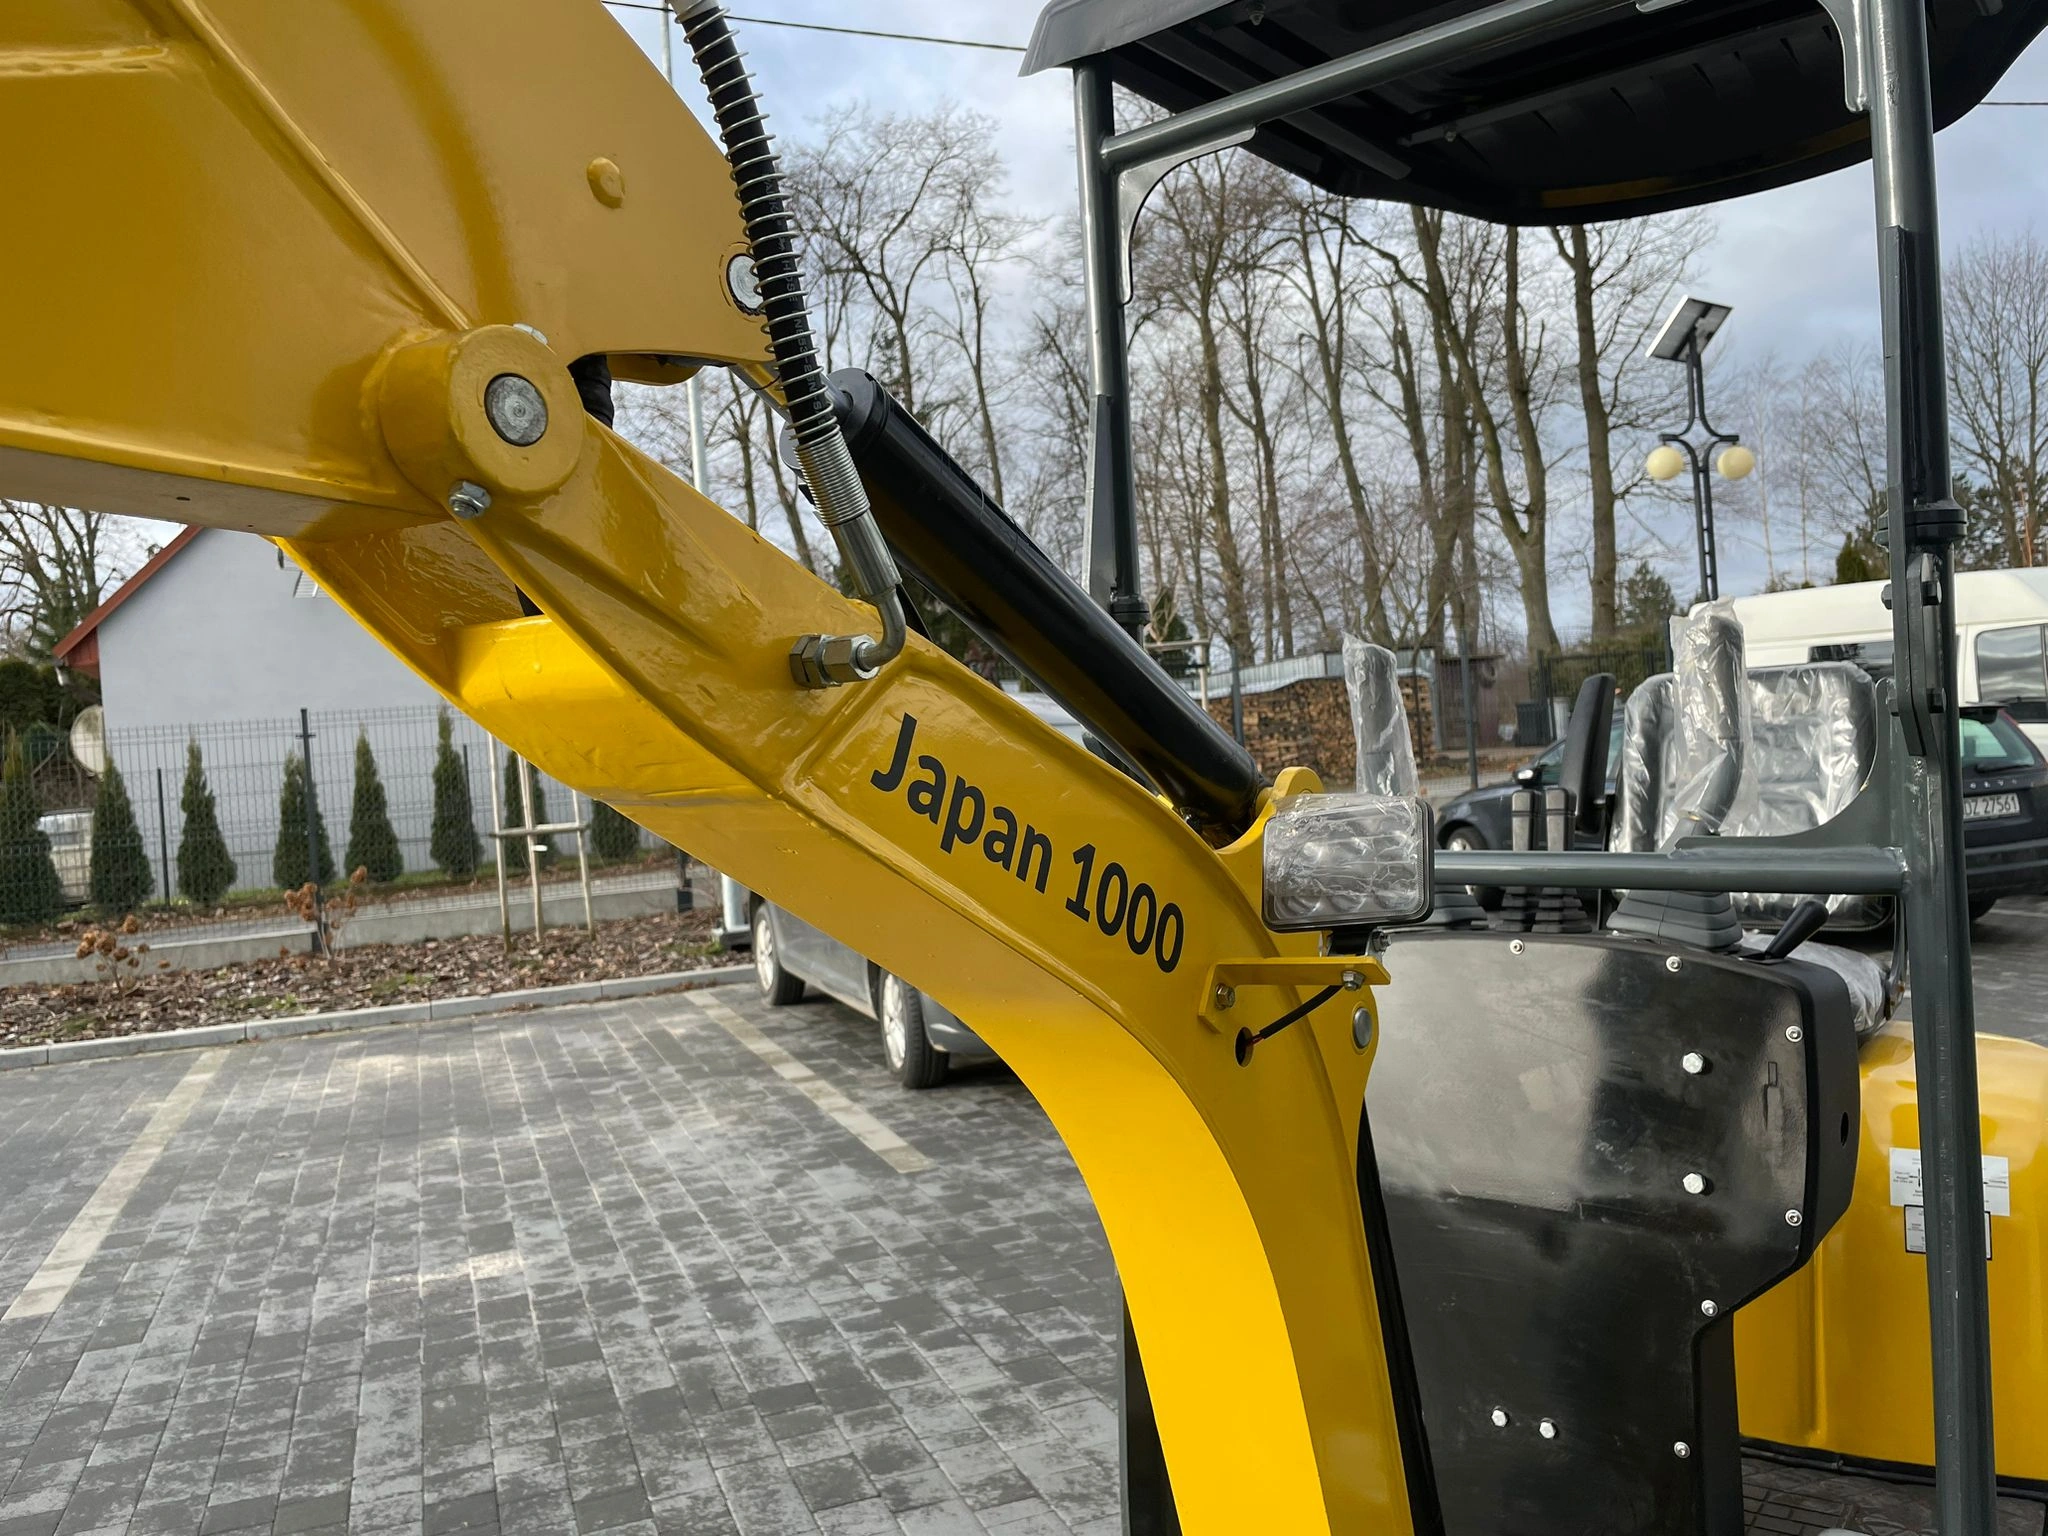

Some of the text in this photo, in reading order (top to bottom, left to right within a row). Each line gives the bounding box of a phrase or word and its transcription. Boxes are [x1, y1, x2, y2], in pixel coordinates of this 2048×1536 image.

[870, 712, 1185, 973] Japan 1000
[1982, 795, 2018, 815] 27561
